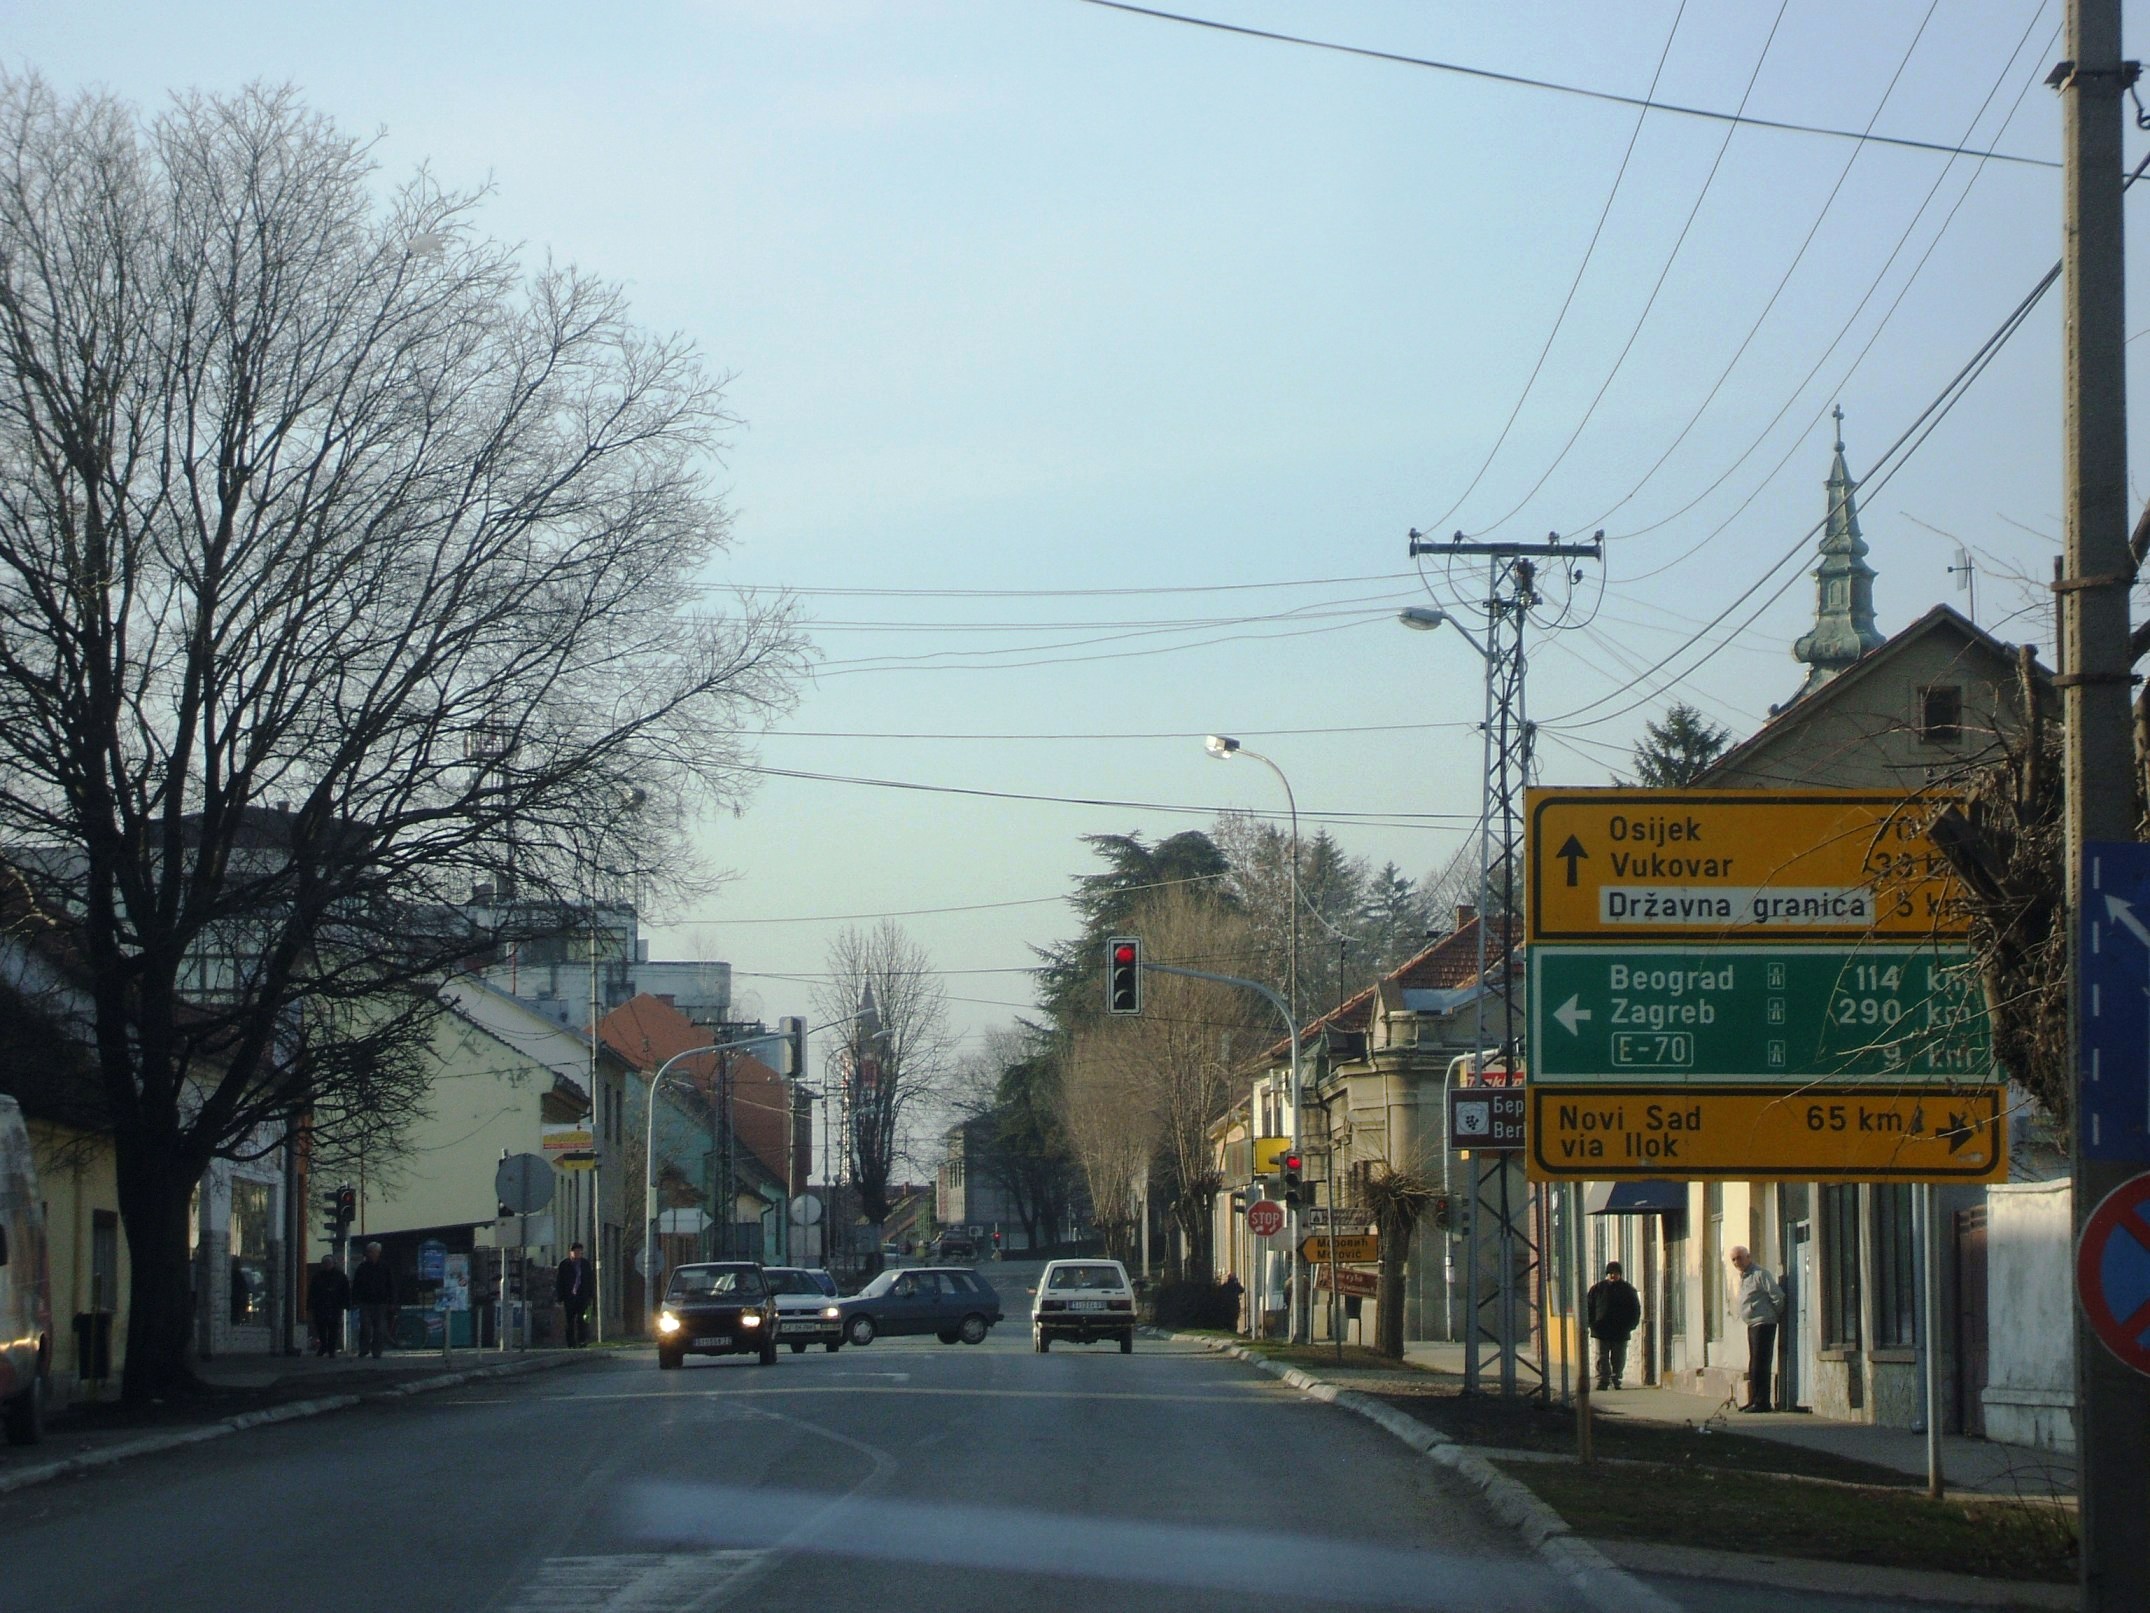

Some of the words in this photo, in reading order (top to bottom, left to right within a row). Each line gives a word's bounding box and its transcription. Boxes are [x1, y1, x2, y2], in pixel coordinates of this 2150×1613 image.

[1609, 816, 1701, 847] Osijek
[1611, 852, 1733, 877] Vukovar
[1609, 891, 1731, 917] Državna
[1753, 892, 1865, 923] granica
[1610, 964, 1734, 996] Beograd
[1856, 965, 1901, 991] 114
[1611, 998, 1715, 1030] Zagreb
[1839, 999, 1901, 1024] 290
[1927, 1000, 1971, 1025] km
[1619, 1036, 1685, 1062] E-70
[1559, 1105, 1623, 1130] Novi
[1646, 1105, 1701, 1130] Sad
[1807, 1105, 1846, 1131] 65
[1859, 1106, 1902, 1131] km
[1561, 1133, 1603, 1157] via
[1626, 1132, 1679, 1157] Ilok
[1251, 1212, 1280, 1225] STOP
